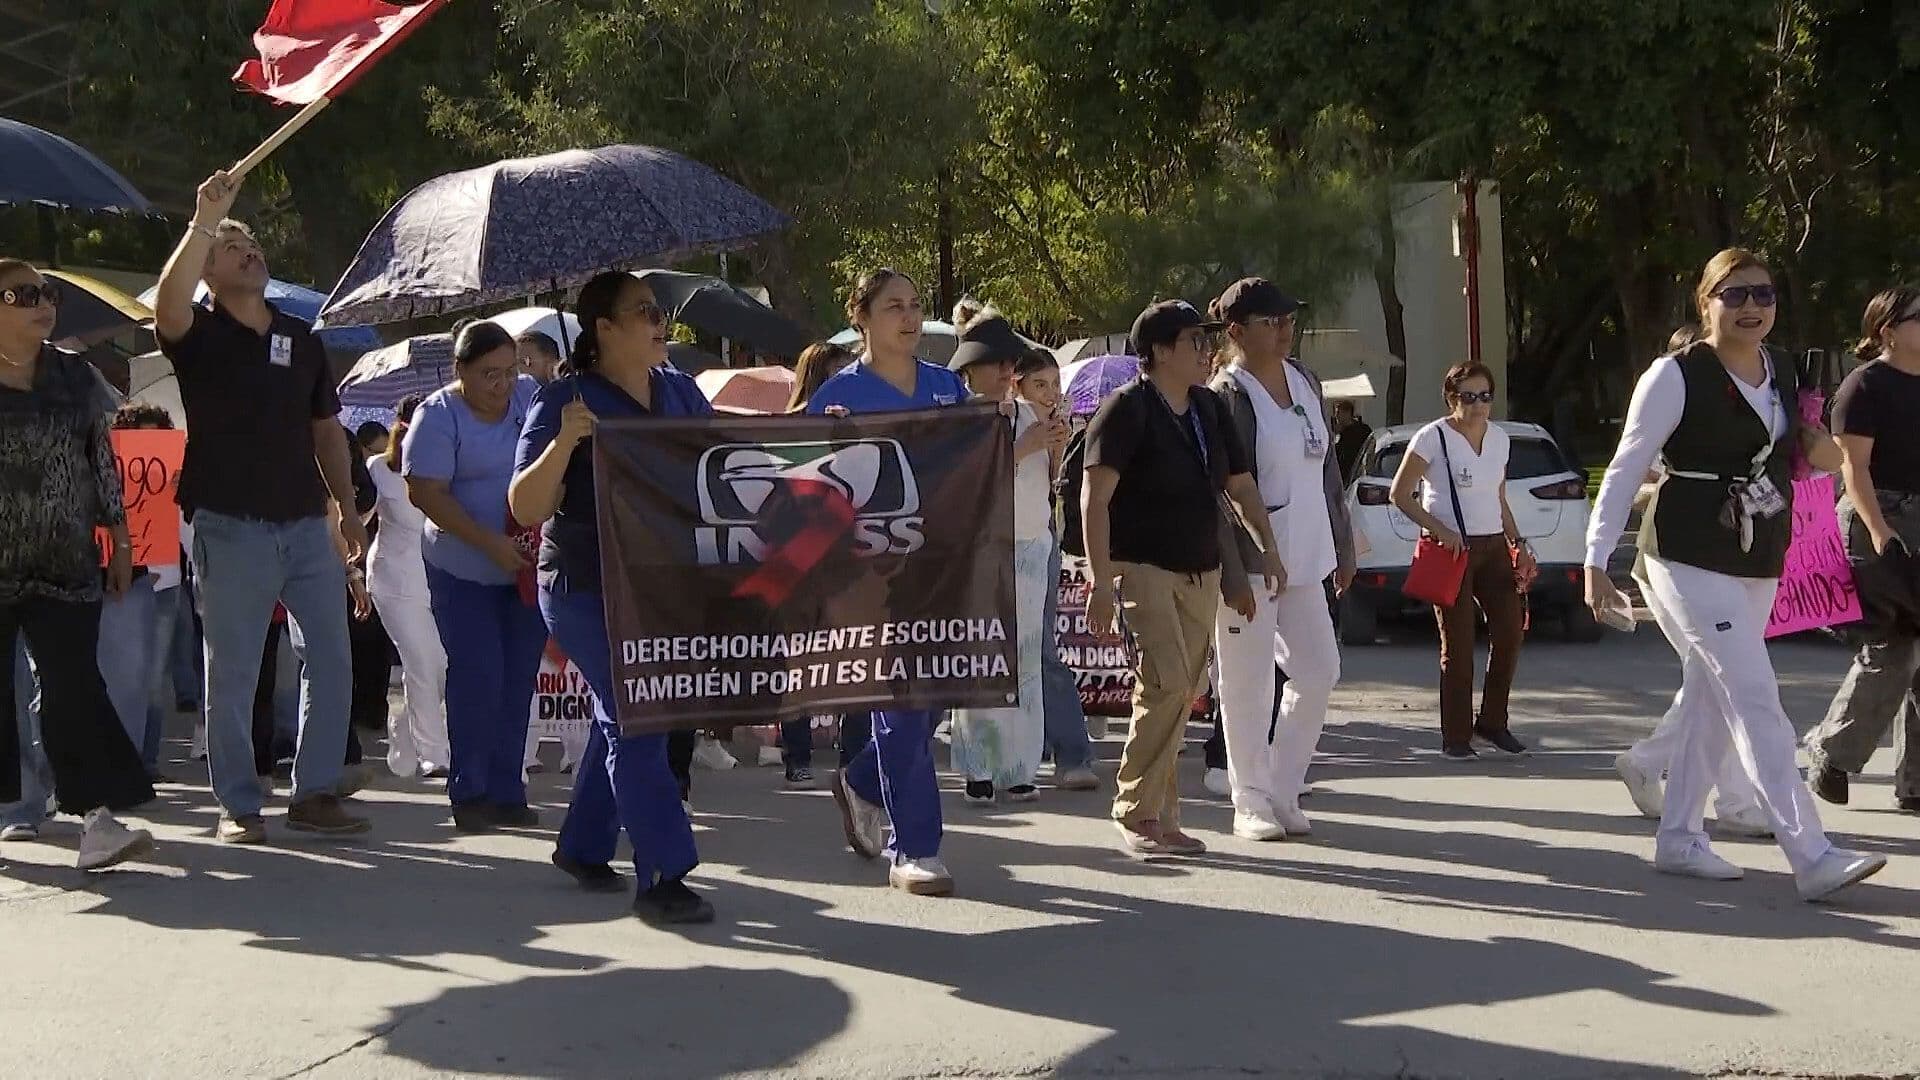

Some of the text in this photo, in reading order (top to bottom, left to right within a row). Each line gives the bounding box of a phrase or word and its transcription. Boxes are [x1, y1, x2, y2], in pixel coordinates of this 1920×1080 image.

[622, 618, 1007, 666] DERECHOHABIENTE ESCUCHA
[623, 667, 741, 703] TAMBIÉN
[751, 669, 802, 695] POR
[807, 663, 829, 688] TI
[836, 659, 868, 685] ES
[874, 656, 907, 681] LA
[916, 654, 1010, 680] LUCHA
